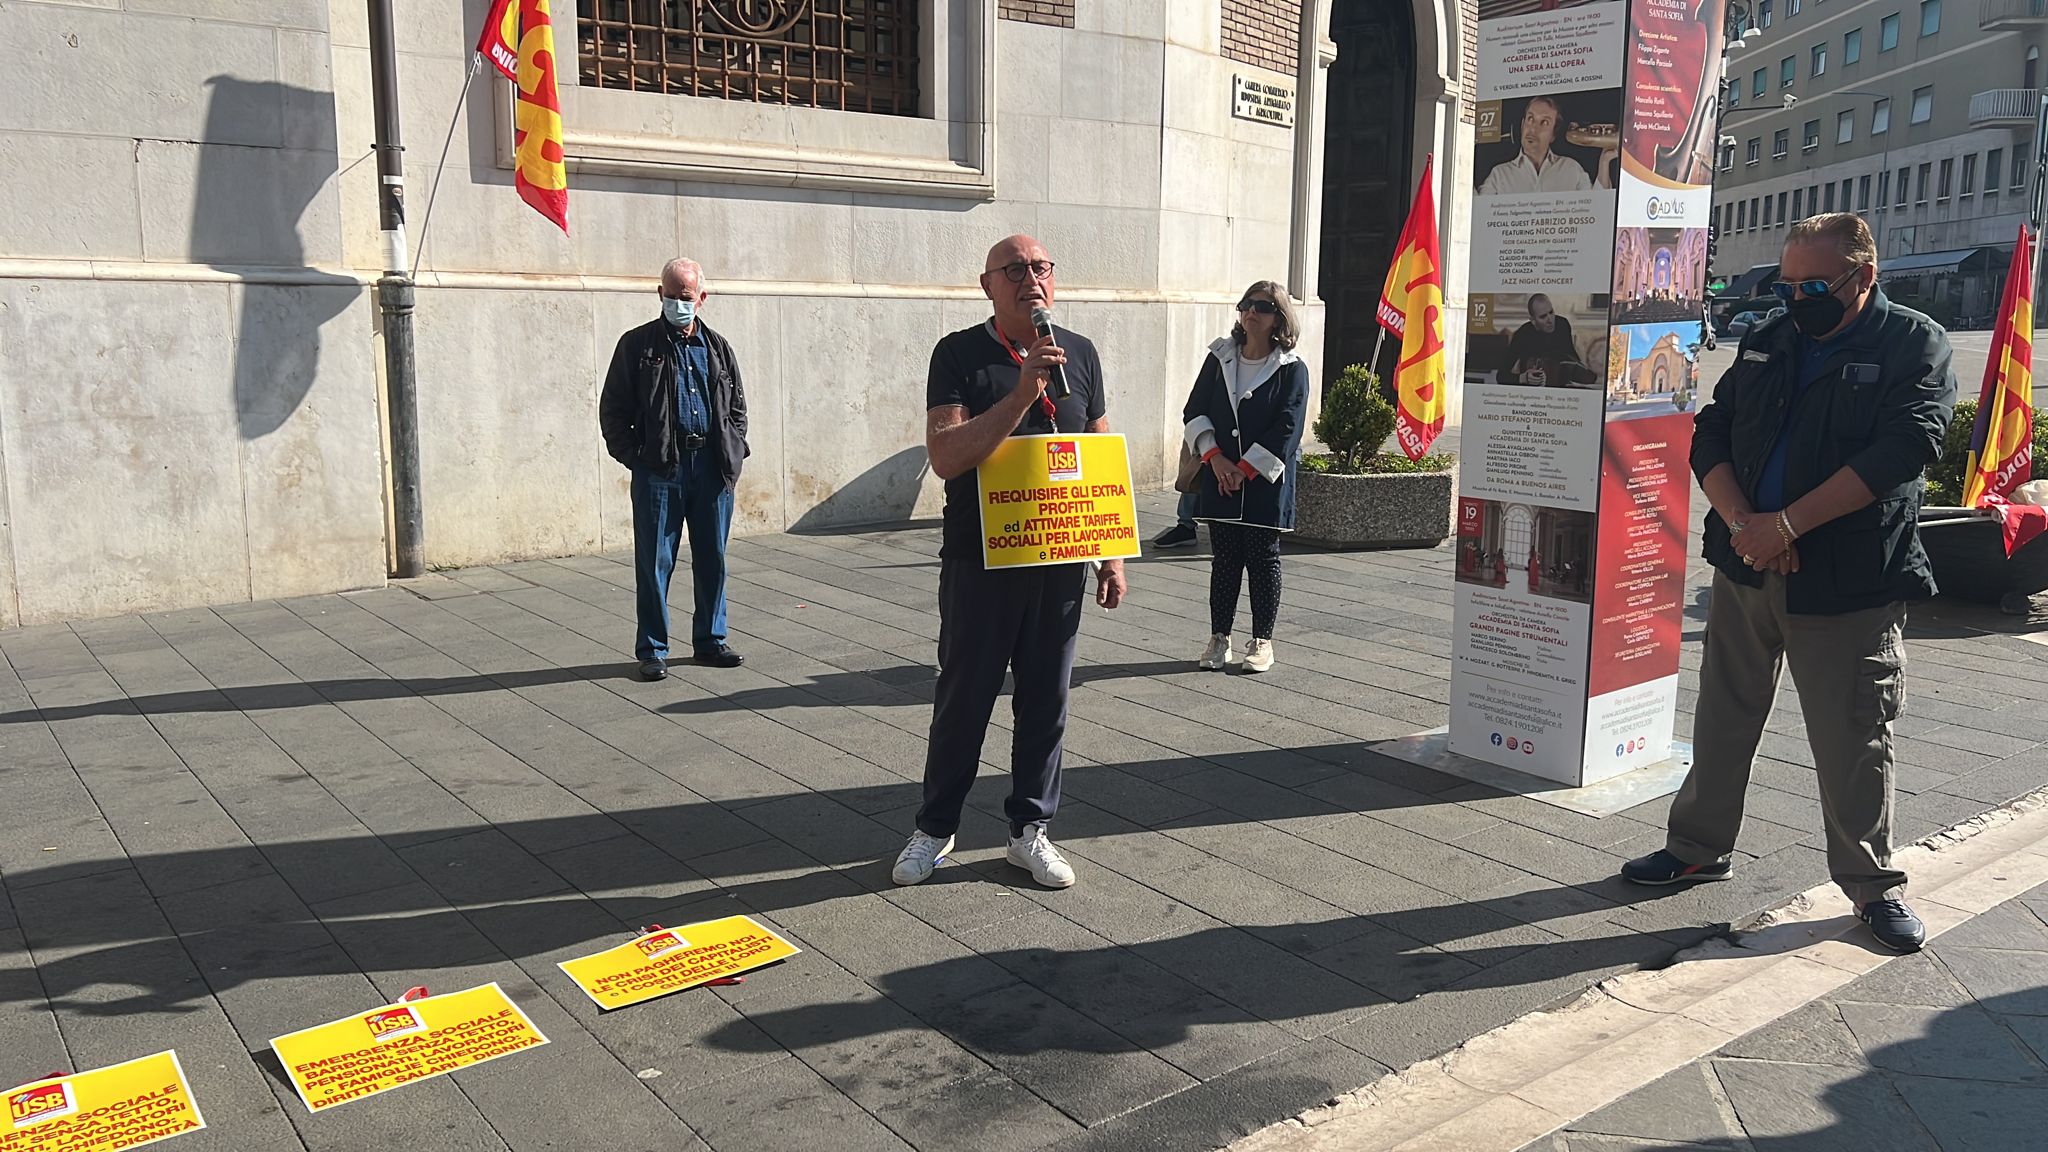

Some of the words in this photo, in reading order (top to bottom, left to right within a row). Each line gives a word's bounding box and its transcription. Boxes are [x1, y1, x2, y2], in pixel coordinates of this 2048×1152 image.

[1649, 9, 1668, 19] SANTA
[1668, 12, 1683, 21] SOFIA
[1503, 53, 1539, 63] ACCADEMIA
[1550, 49, 1572, 58] SANTA
[1574, 47, 1593, 55] SOFIA
[1517, 46, 1546, 54] ORCHESTRA
[1509, 66, 1524, 74] UNA
[1526, 63, 1544, 72] SERA
[1480, 112, 1496, 126] 27
[1474, 304, 1486, 316] 12
[1501, 415, 1530, 424] STEFANO
[1533, 417, 1582, 427] PIETRODARCHI
[1049, 452, 1076, 470] USB
[989, 487, 1068, 504] REQUISIRE
[1071, 486, 1088, 498] GLI
[1092, 484, 1126, 497] EXTRA
[1496, 478, 1514, 486] ROMA
[1522, 480, 1547, 489] BUENOS
[1548, 482, 1566, 490] AIRES
[1039, 501, 1094, 516] PROFITTI
[1466, 506, 1476, 519] 19
[1004, 521, 1019, 532] ed
[1024, 516, 1080, 532] ATTIVARE
[1082, 513, 1120, 527] TARIFFE
[988, 533, 1042, 549] SOCIALI
[1046, 531, 1070, 545] PER
[1073, 526, 1134, 542] LAVORATORI
[1040, 551, 1046, 560] e
[1050, 544, 1101, 559] FAMIGLIE
[1470, 622, 1494, 632] GRANDI
[1496, 627, 1520, 638] PAGINE
[1522, 632, 1568, 647] STRUMENTALI
[1478, 614, 1512, 626] ACCADEMIA
[1522, 622, 1541, 631] SANTA
[1542, 626, 1560, 635] SOFIA
[1471, 644, 1497, 654] FRANCESCO
[641, 936, 680, 953] USB
[591, 982, 614, 995] LE
[615, 972, 657, 988] CRISI
[658, 963, 685, 976] DEI
[688, 936, 774, 968] CAPITALISTI
[595, 972, 630, 986] NON
[632, 943, 728, 977] PAGHEREMO
[729, 935, 757, 946] NOI
[630, 974, 678, 992] COSTI
[679, 959, 730, 979] DELLE
[731, 945, 772, 962] LORO
[660, 968, 722, 990] GUERRE
[369, 1014, 416, 1037] USB
[295, 1035, 426, 1073] EMERGENZA
[429, 1009, 513, 1038] SOCIALE
[306, 1052, 394, 1080] BARBONI,
[396, 1038, 455, 1057] SENZA
[456, 1020, 515, 1041] TETTO,
[304, 1055, 418, 1090] PENSIONATI,
[420, 1023, 525, 1058] LAVORATORI
[338, 1060, 423, 1090] FAMIGLIE
[426, 1035, 521, 1066] CHIEDONO:
[312, 1082, 380, 1109] DIRITTI
[394, 1061, 458, 1083] SALARI
[473, 1036, 543, 1060] DIGNITÀ
[12, 1092, 65, 1119] USB
[76, 1084, 179, 1121] SOCIALE
[31, 1119, 100, 1144] SENZA
[105, 1098, 177, 1122] TETTO,
[56, 1102, 186, 1145] LAVORATORI
[58, 1118, 177, 1152] CHIEDONO:
[112, 1119, 201, 1149] DIGNITÀ
